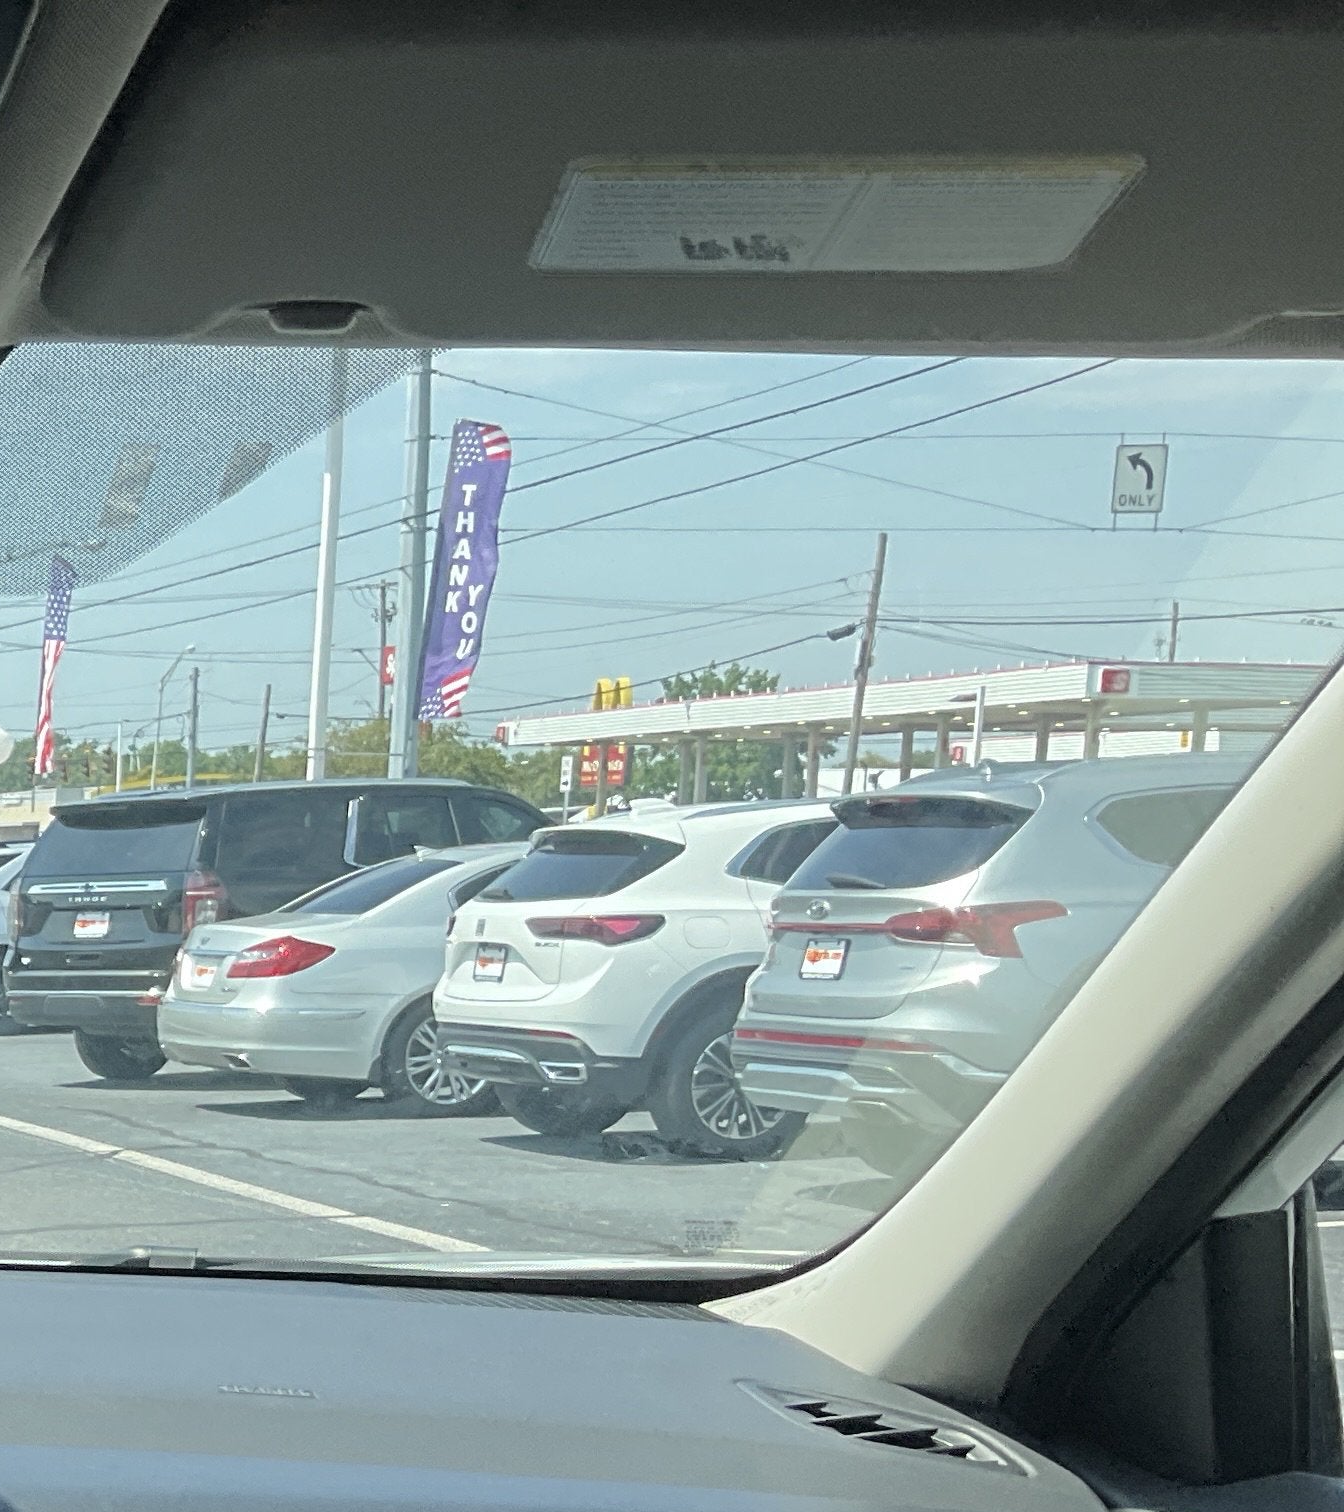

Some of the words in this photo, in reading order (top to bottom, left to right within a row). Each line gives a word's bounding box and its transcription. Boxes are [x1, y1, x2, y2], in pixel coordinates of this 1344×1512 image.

[1118, 494, 1155, 506] ONLY
[445, 484, 476, 613] THANK
[456, 585, 483, 660] YOU
